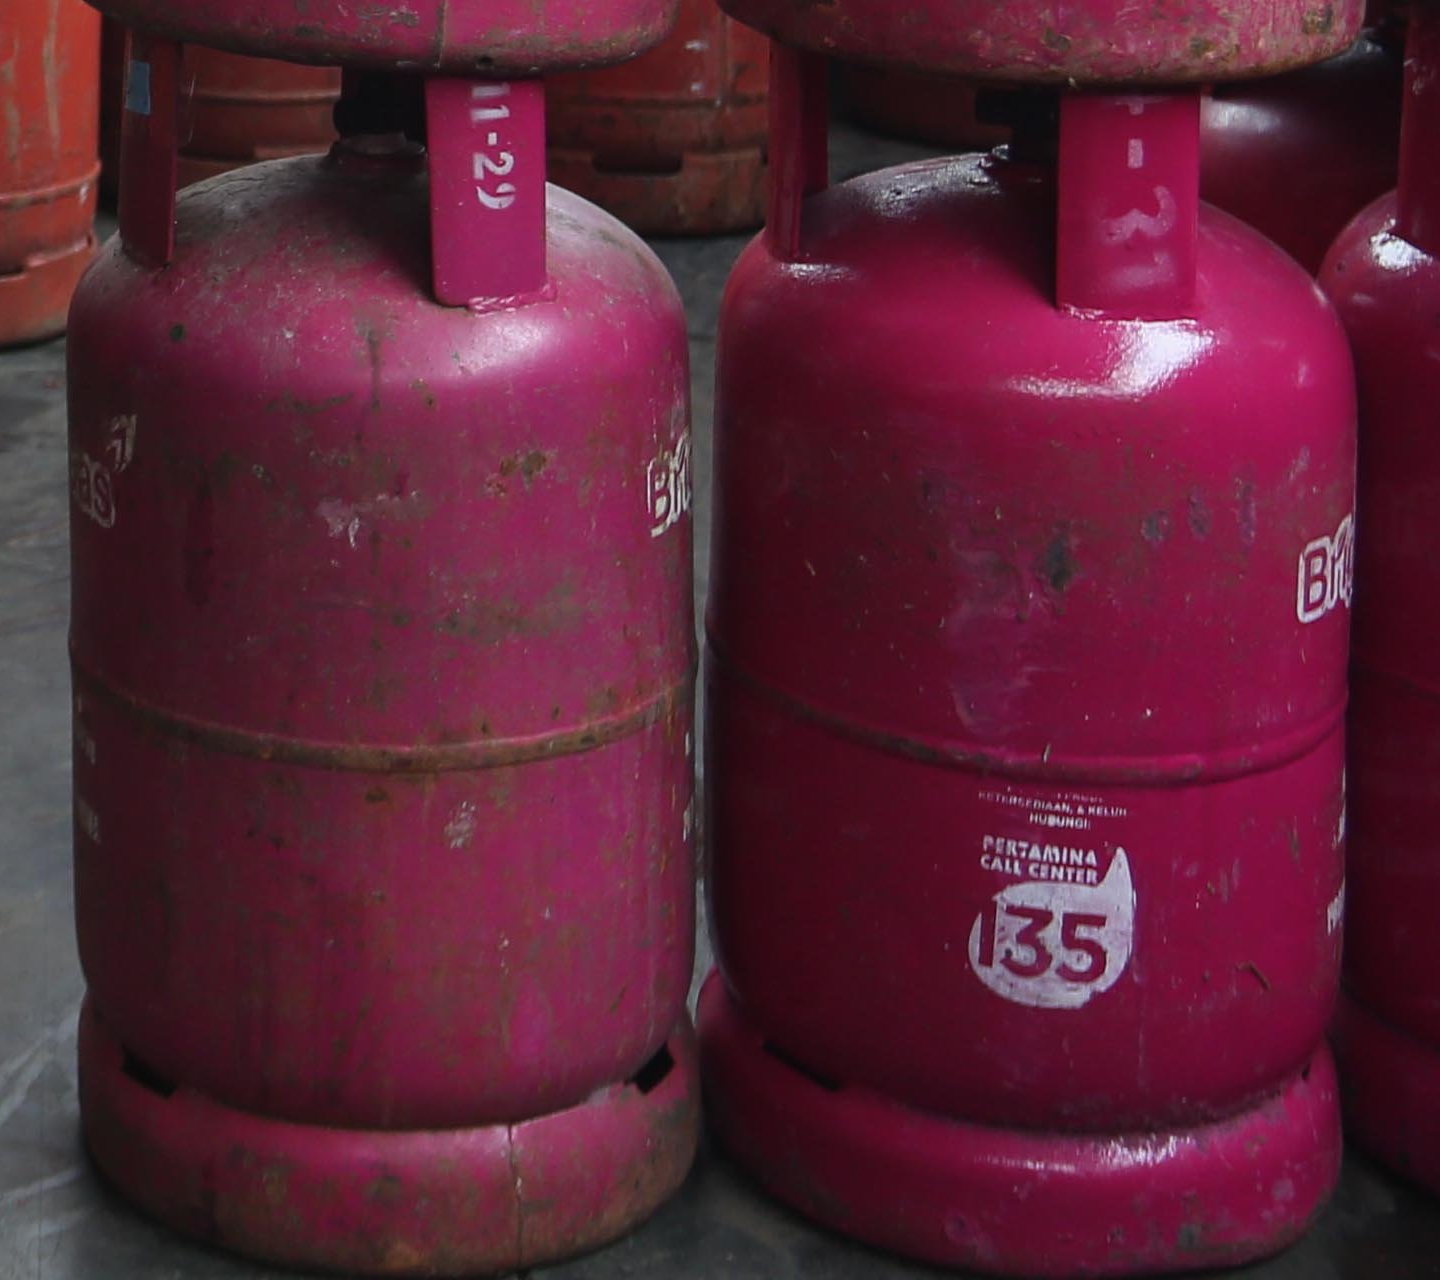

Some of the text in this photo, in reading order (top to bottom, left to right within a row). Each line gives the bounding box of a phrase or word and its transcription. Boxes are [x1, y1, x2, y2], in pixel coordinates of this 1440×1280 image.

[983, 834, 1098, 867] PERTAMINA
[980, 853, 1098, 885] CALL CENTER
[978, 904, 1108, 984] 135
